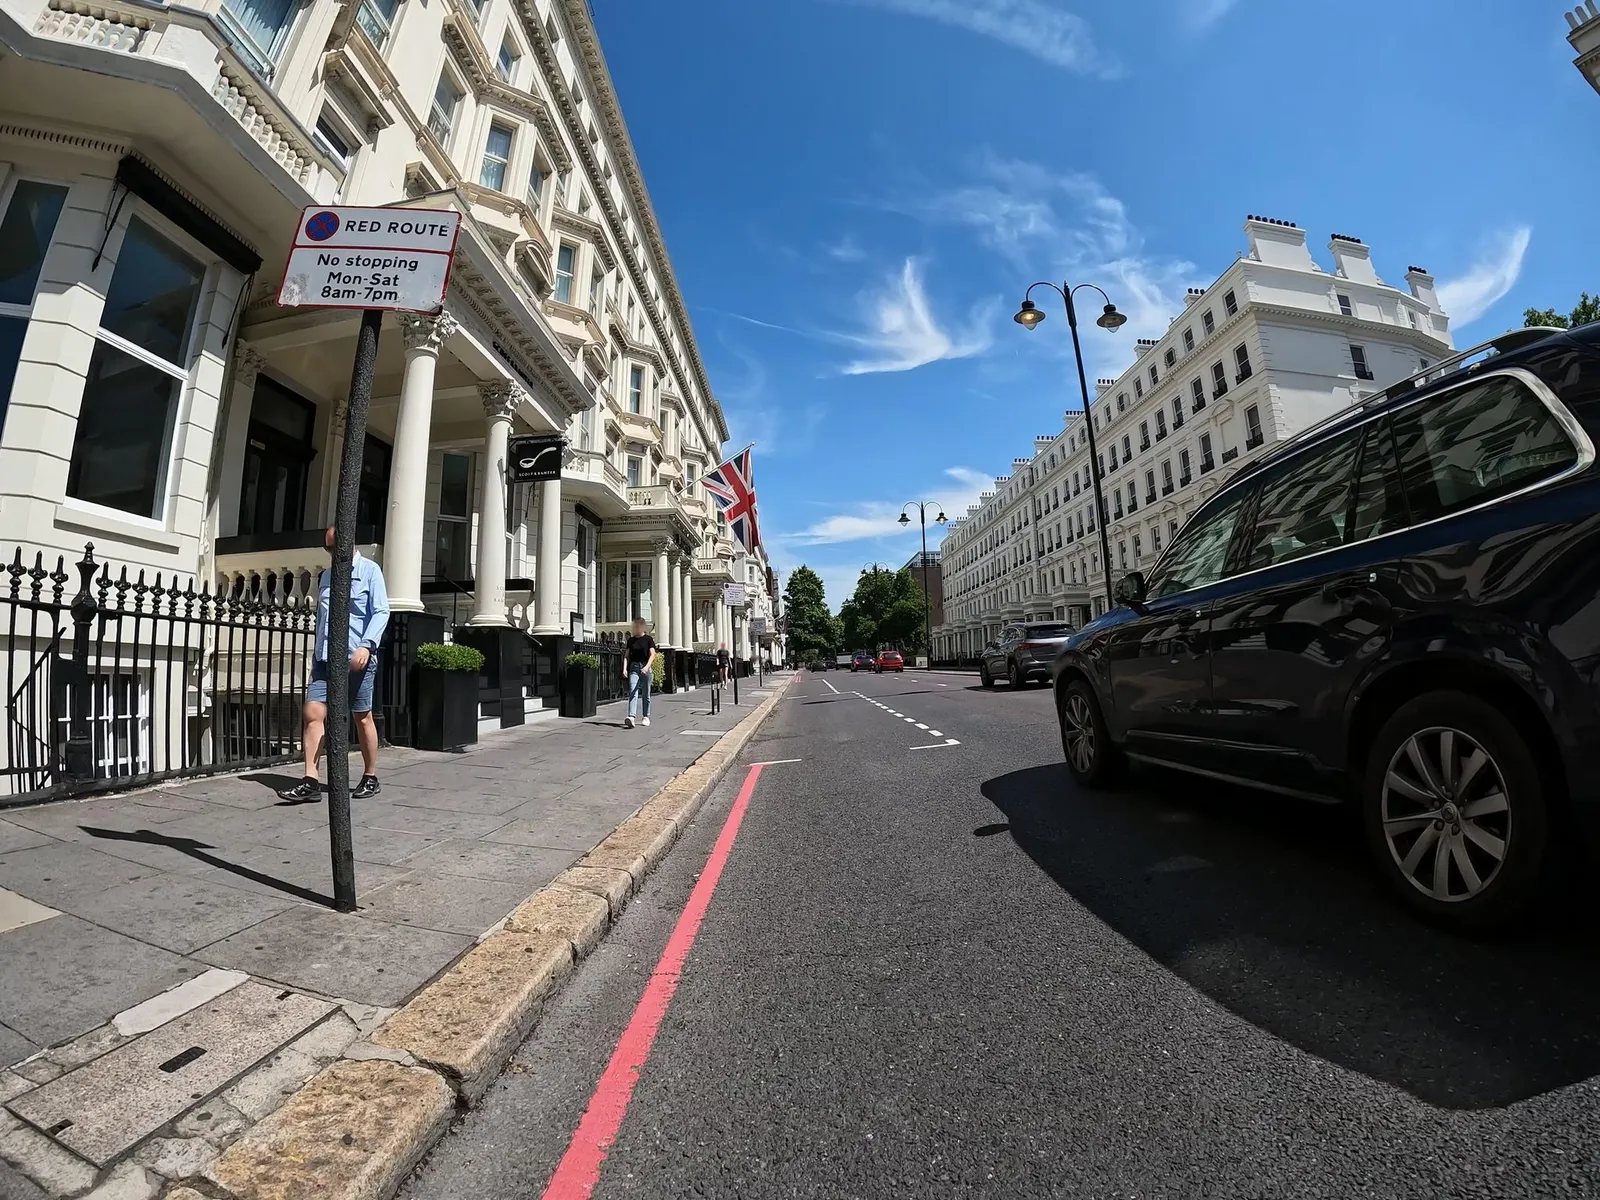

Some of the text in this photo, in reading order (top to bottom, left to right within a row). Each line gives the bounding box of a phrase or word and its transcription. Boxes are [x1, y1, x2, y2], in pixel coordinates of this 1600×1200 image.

[345, 220, 449, 237] RED ROUTE
[317, 253, 419, 271] No stopping
[327, 272, 400, 286] Mon-Sat
[321, 286, 398, 302] 8am-7pm
